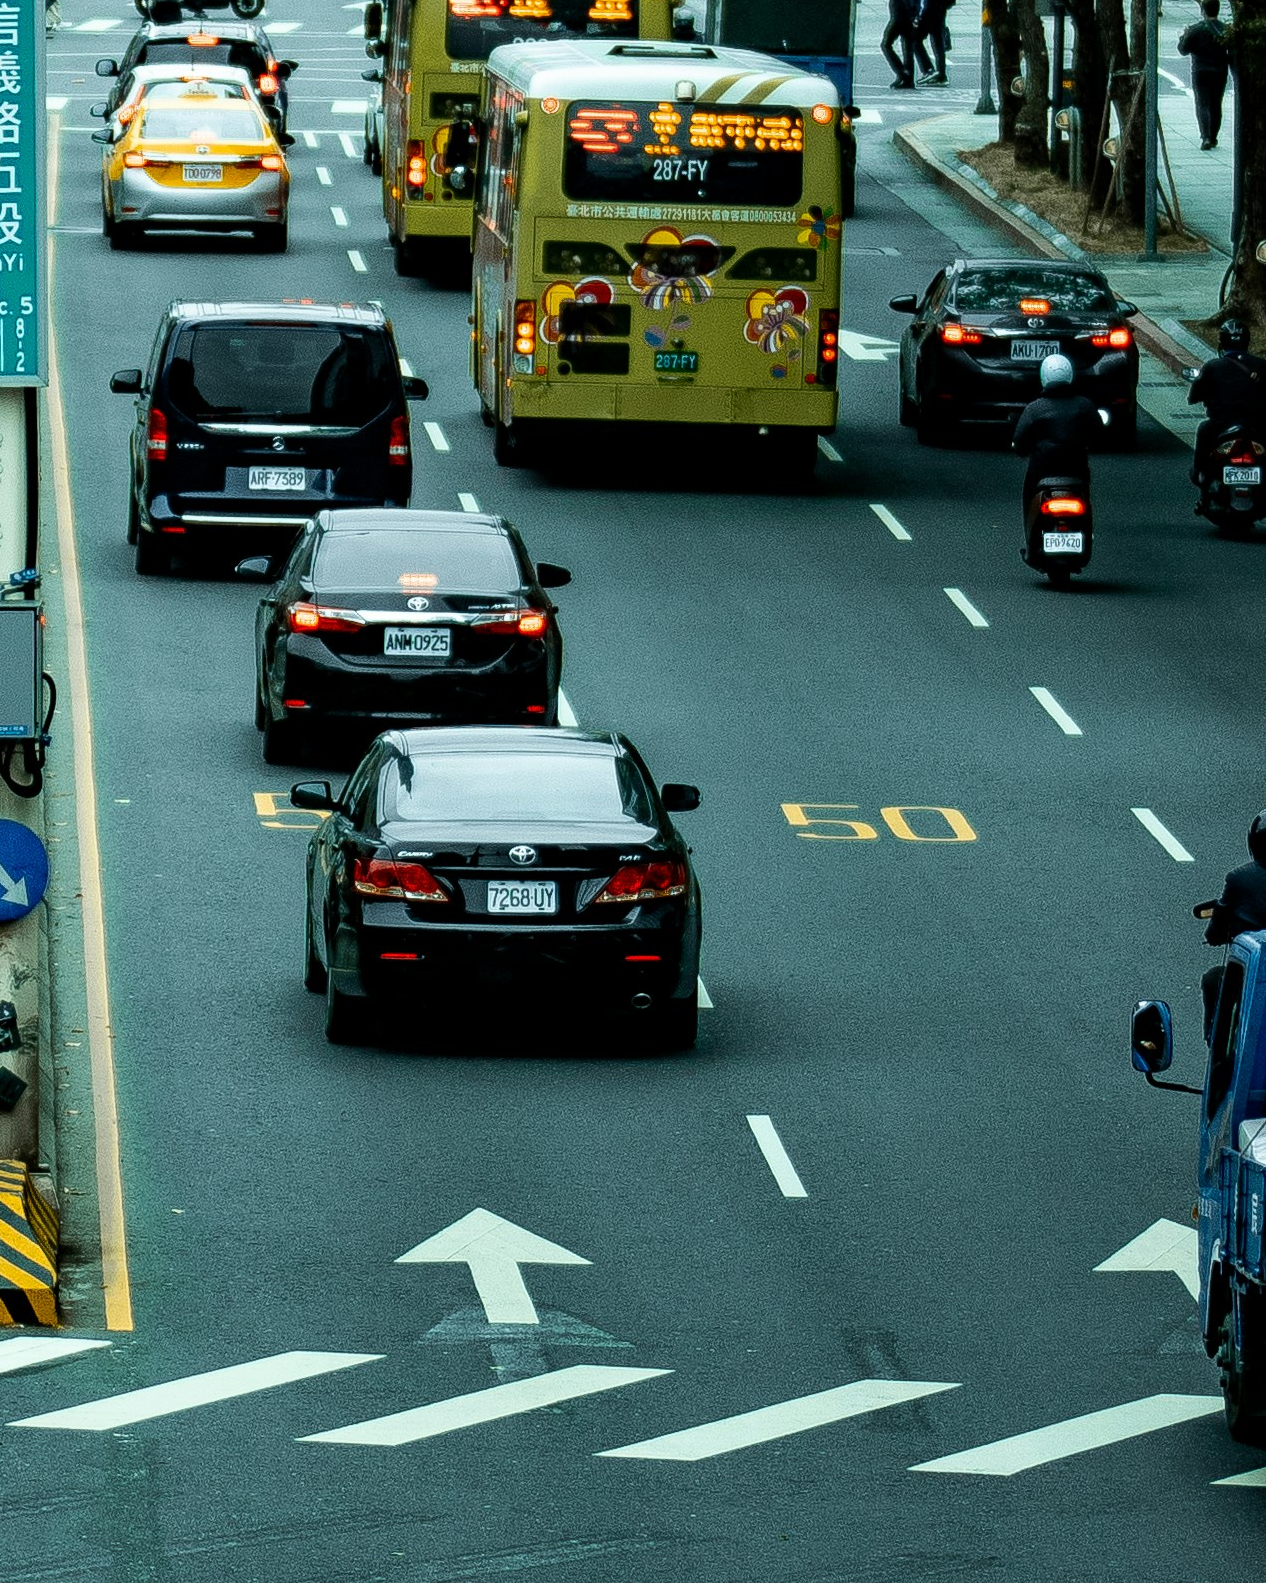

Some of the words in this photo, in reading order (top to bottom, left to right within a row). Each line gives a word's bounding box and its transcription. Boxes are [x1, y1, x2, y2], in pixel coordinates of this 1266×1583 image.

[653, 159, 708, 181] 287-FY
[20, 296, 33, 315] 5
[656, 354, 696, 369] 287-FY
[250, 471, 304, 486] ARF-7389
[386, 633, 449, 651] ANM-0925
[780, 803, 977, 842] 50
[489, 887, 554, 908] 7268-UY
